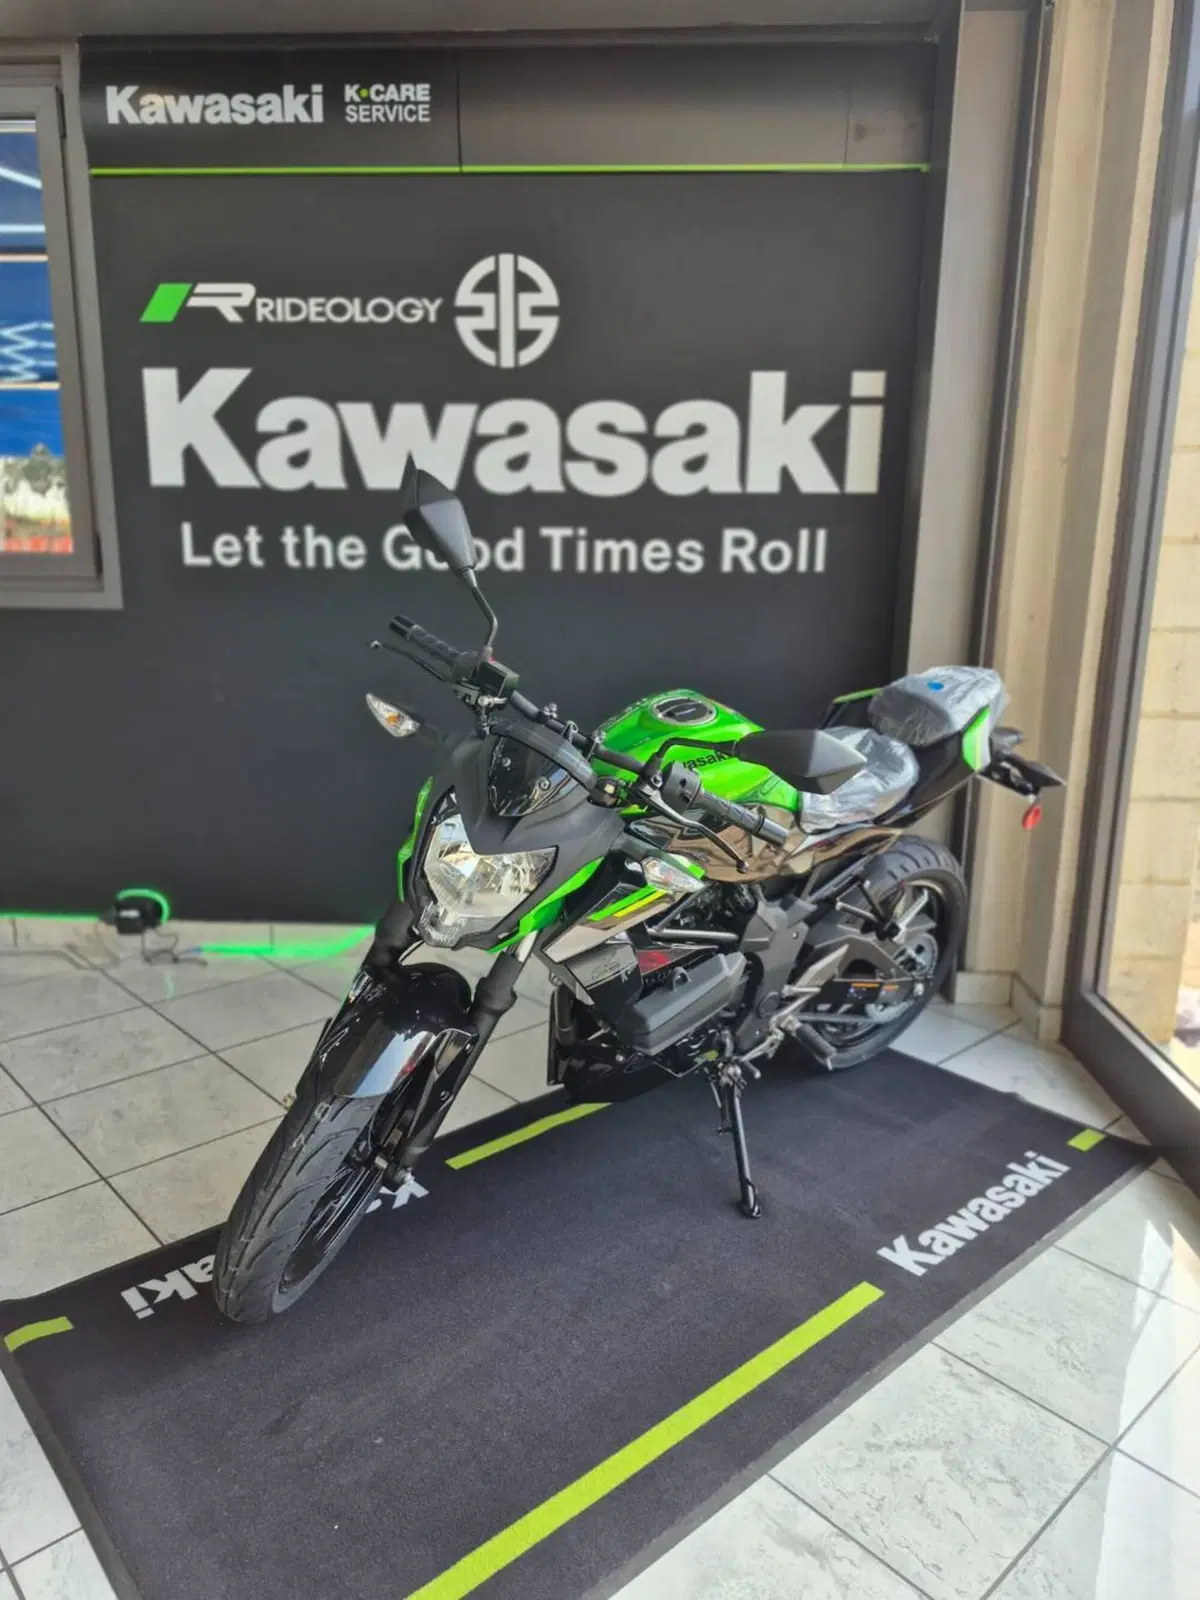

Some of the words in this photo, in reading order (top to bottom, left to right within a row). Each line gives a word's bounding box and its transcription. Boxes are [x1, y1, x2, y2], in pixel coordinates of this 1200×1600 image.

[105, 84, 324, 125] Kawasaki
[344, 103, 431, 123] SERVICE
[254, 297, 443, 323] RIDEOLOGY
[142, 366, 887, 497] Kawasaki
[181, 521, 265, 568] Let
[281, 524, 367, 569] the
[539, 525, 705, 574] Times
[720, 527, 828, 574] Roll
[876, 1150, 1071, 1277] Kawasaki
